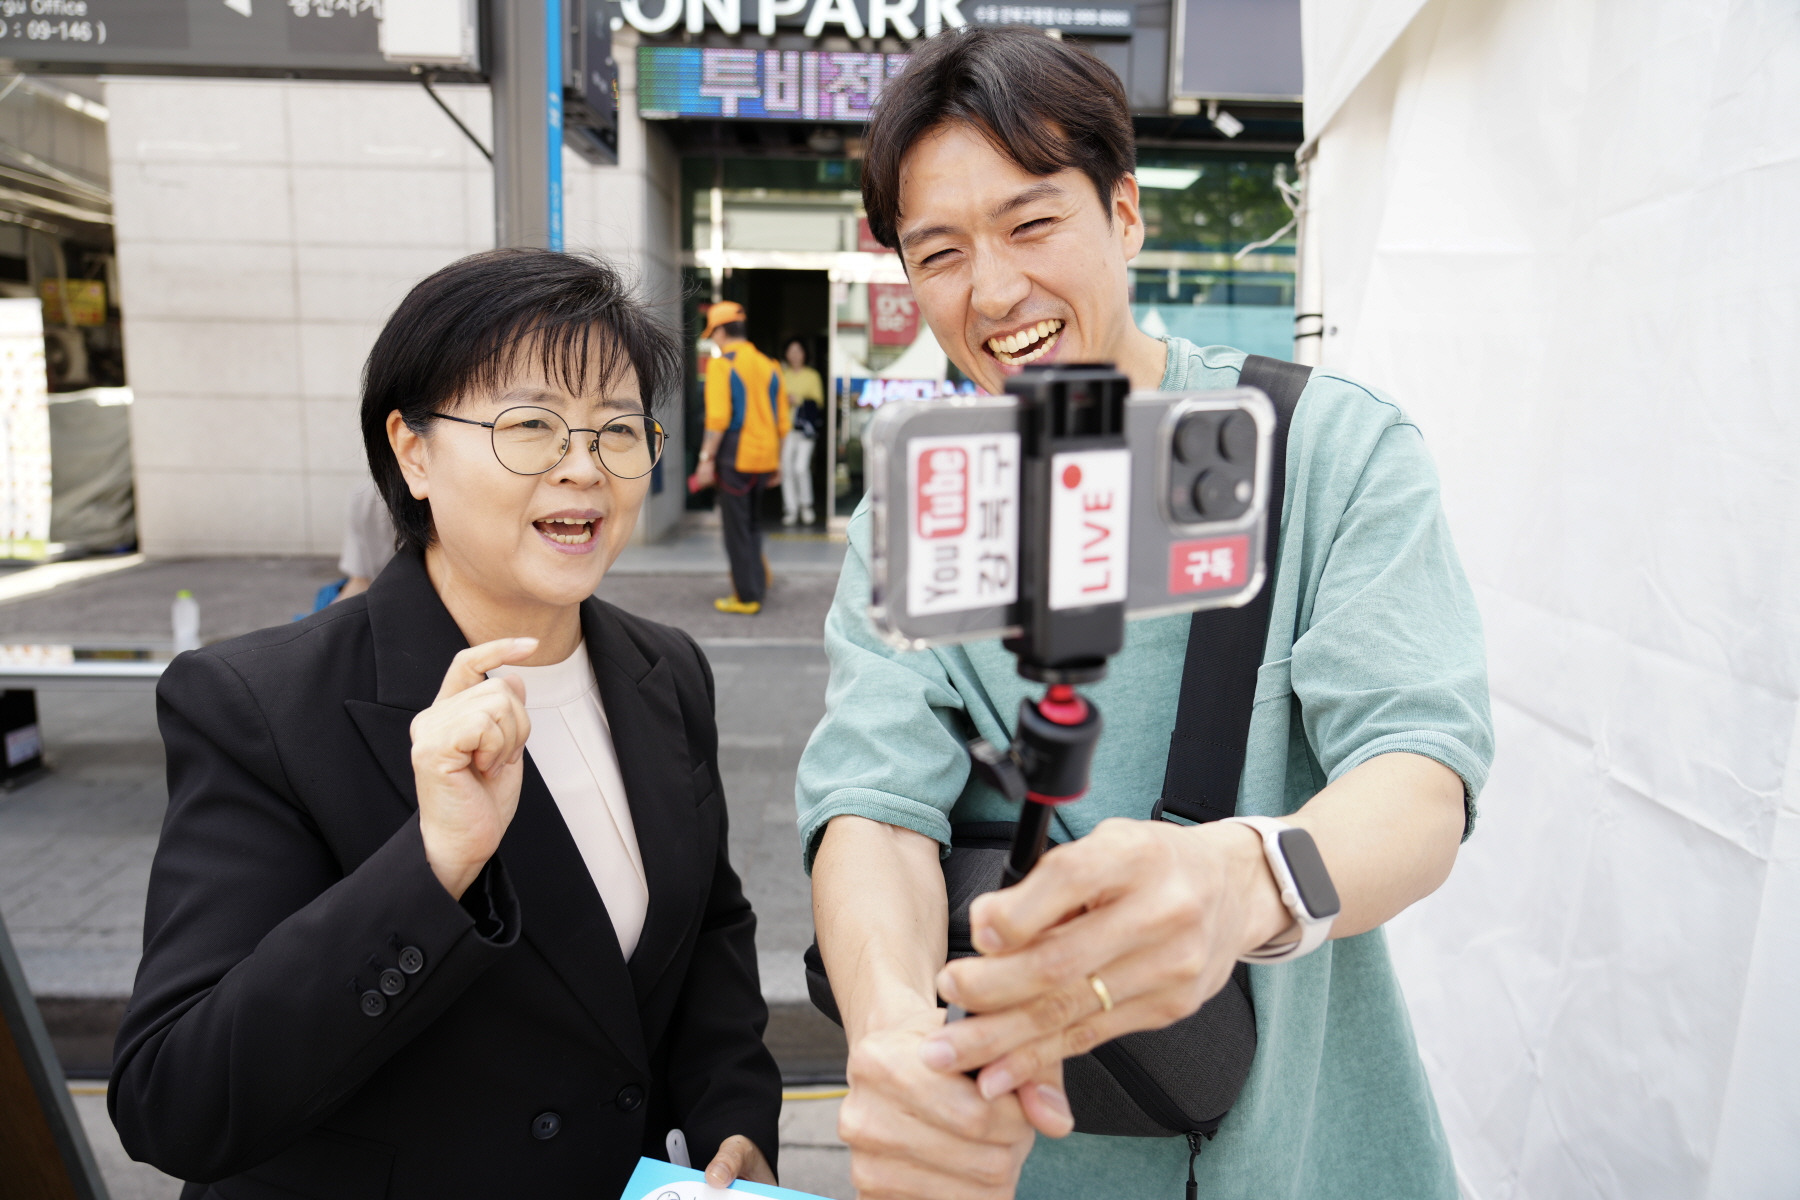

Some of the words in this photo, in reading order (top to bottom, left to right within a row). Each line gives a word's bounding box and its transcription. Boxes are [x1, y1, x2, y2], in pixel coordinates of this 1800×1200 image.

[27, 19, 93, 41] 09-146
[31, 0, 88, 17] Office
[610, 0, 741, 35] ON
[758, 0, 967, 40] PARK
[921, 448, 968, 604] YouTube
[977, 443, 1013, 595] 강북구
[1080, 490, 1114, 594] LIVE
